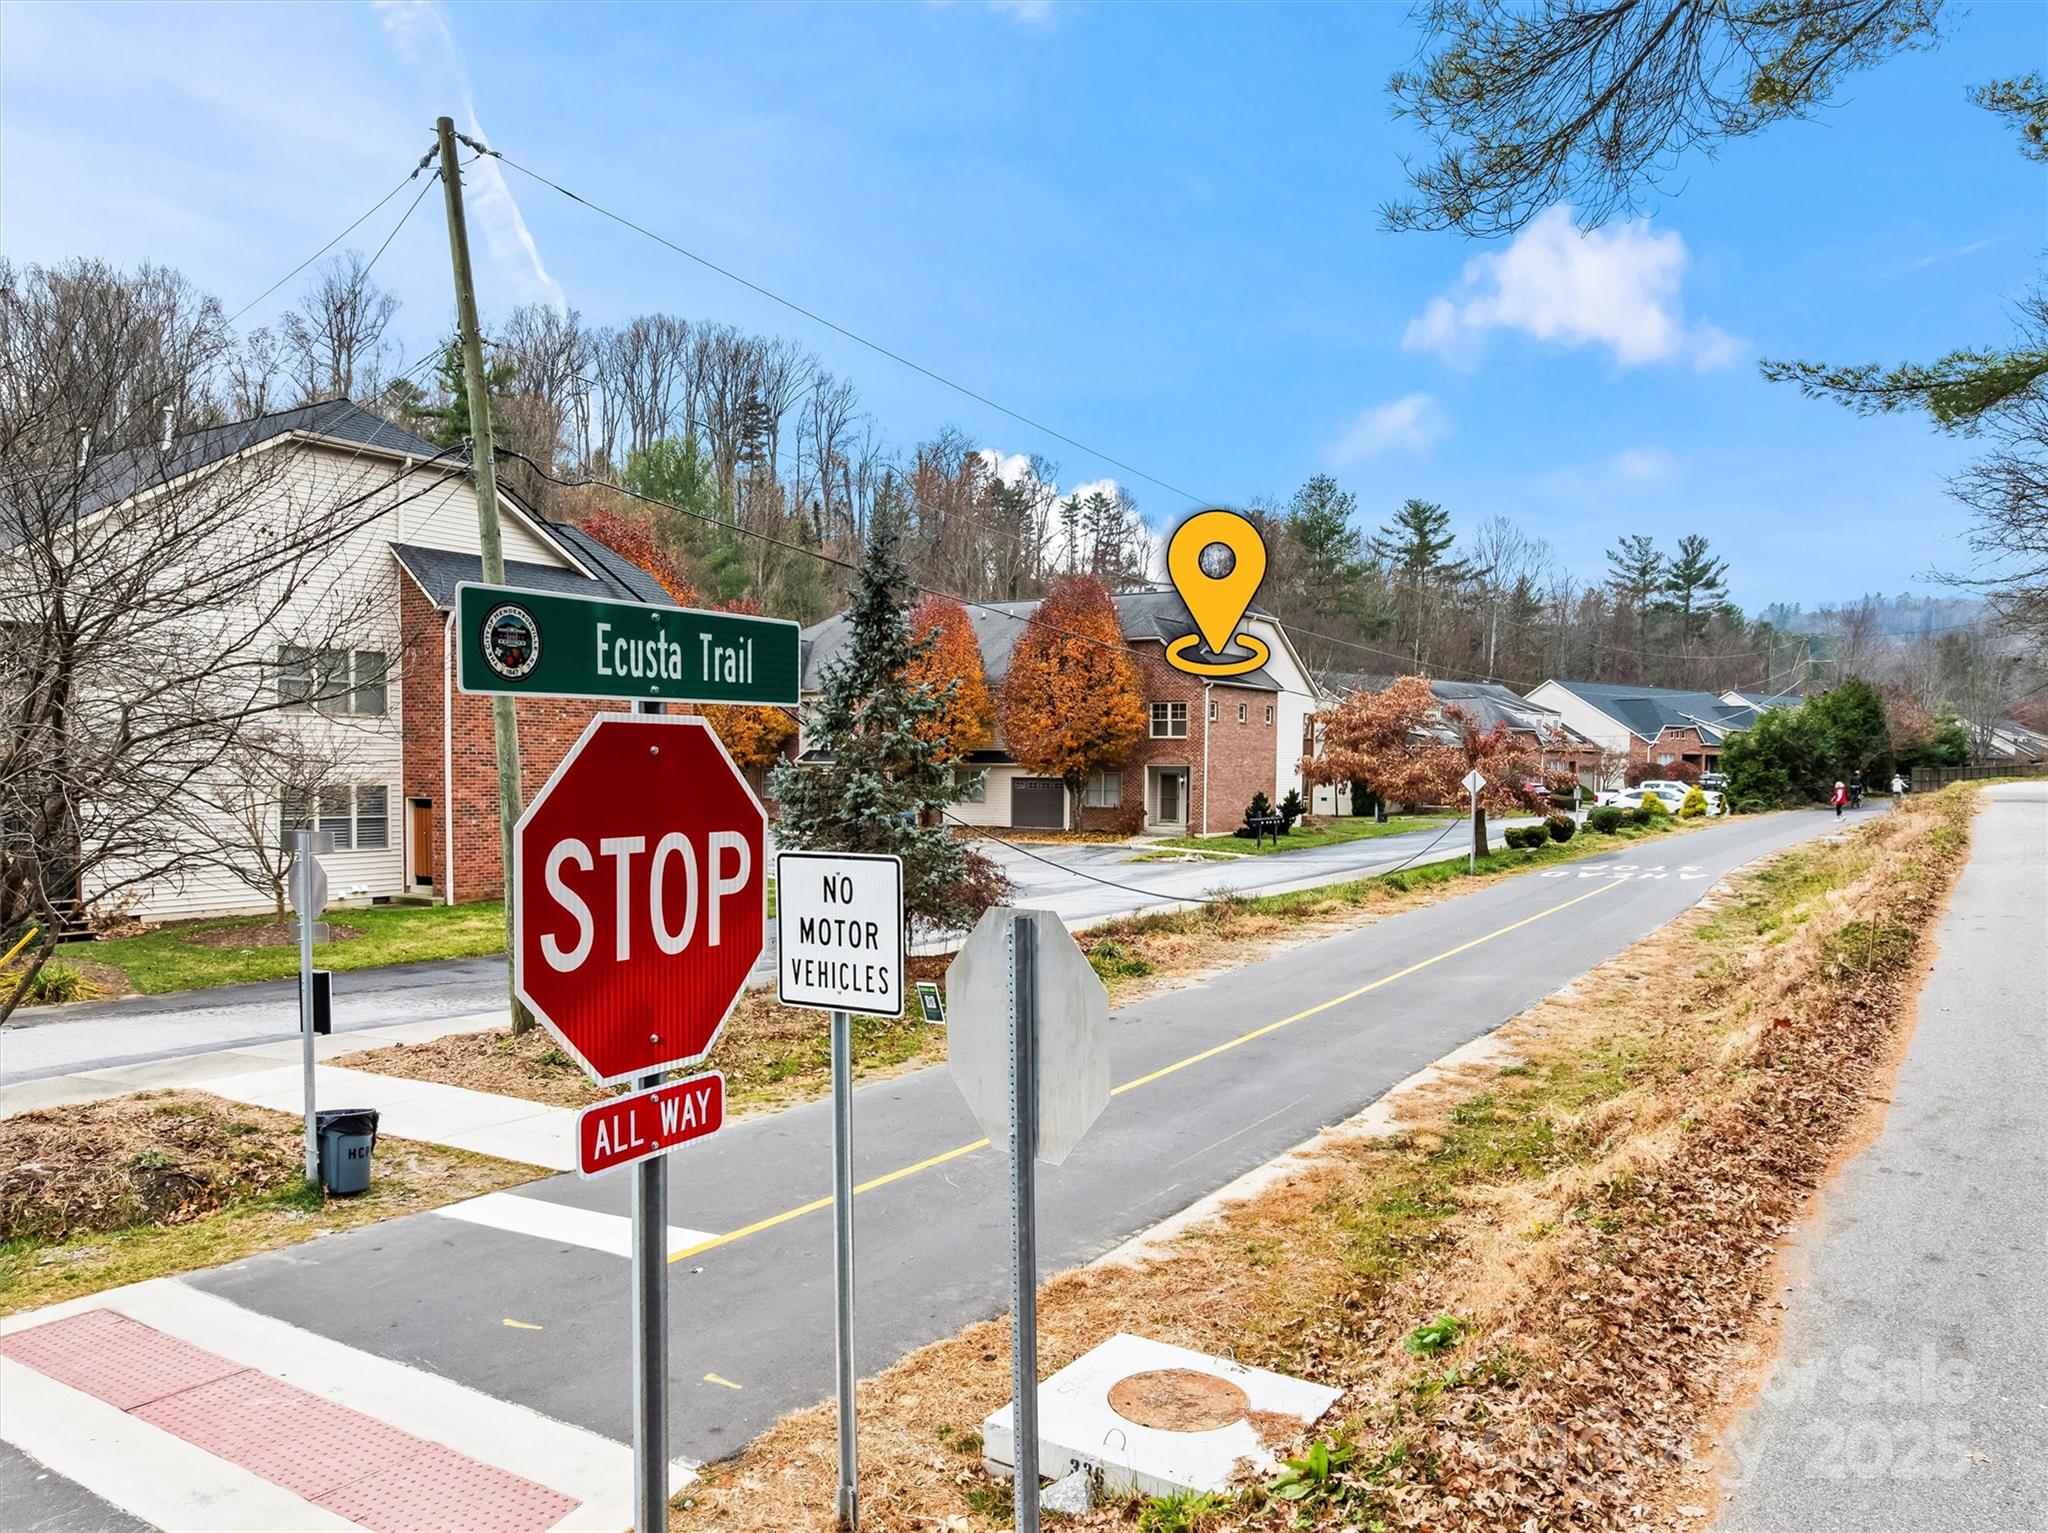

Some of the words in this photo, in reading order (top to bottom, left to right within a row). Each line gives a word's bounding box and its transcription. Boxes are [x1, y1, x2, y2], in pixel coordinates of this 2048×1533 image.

[487, 618, 495, 630] OF
[488, 650, 498, 667] THE
[597, 622, 682, 680] Ecusta
[699, 633, 752, 684] Trail
[540, 831, 751, 973] STOP
[823, 876, 853, 904] NO
[800, 917, 879, 950] MOTOR
[791, 958, 889, 995] VEHICLES
[594, 1110, 645, 1161] ALL
[660, 1087, 712, 1137] WAY
